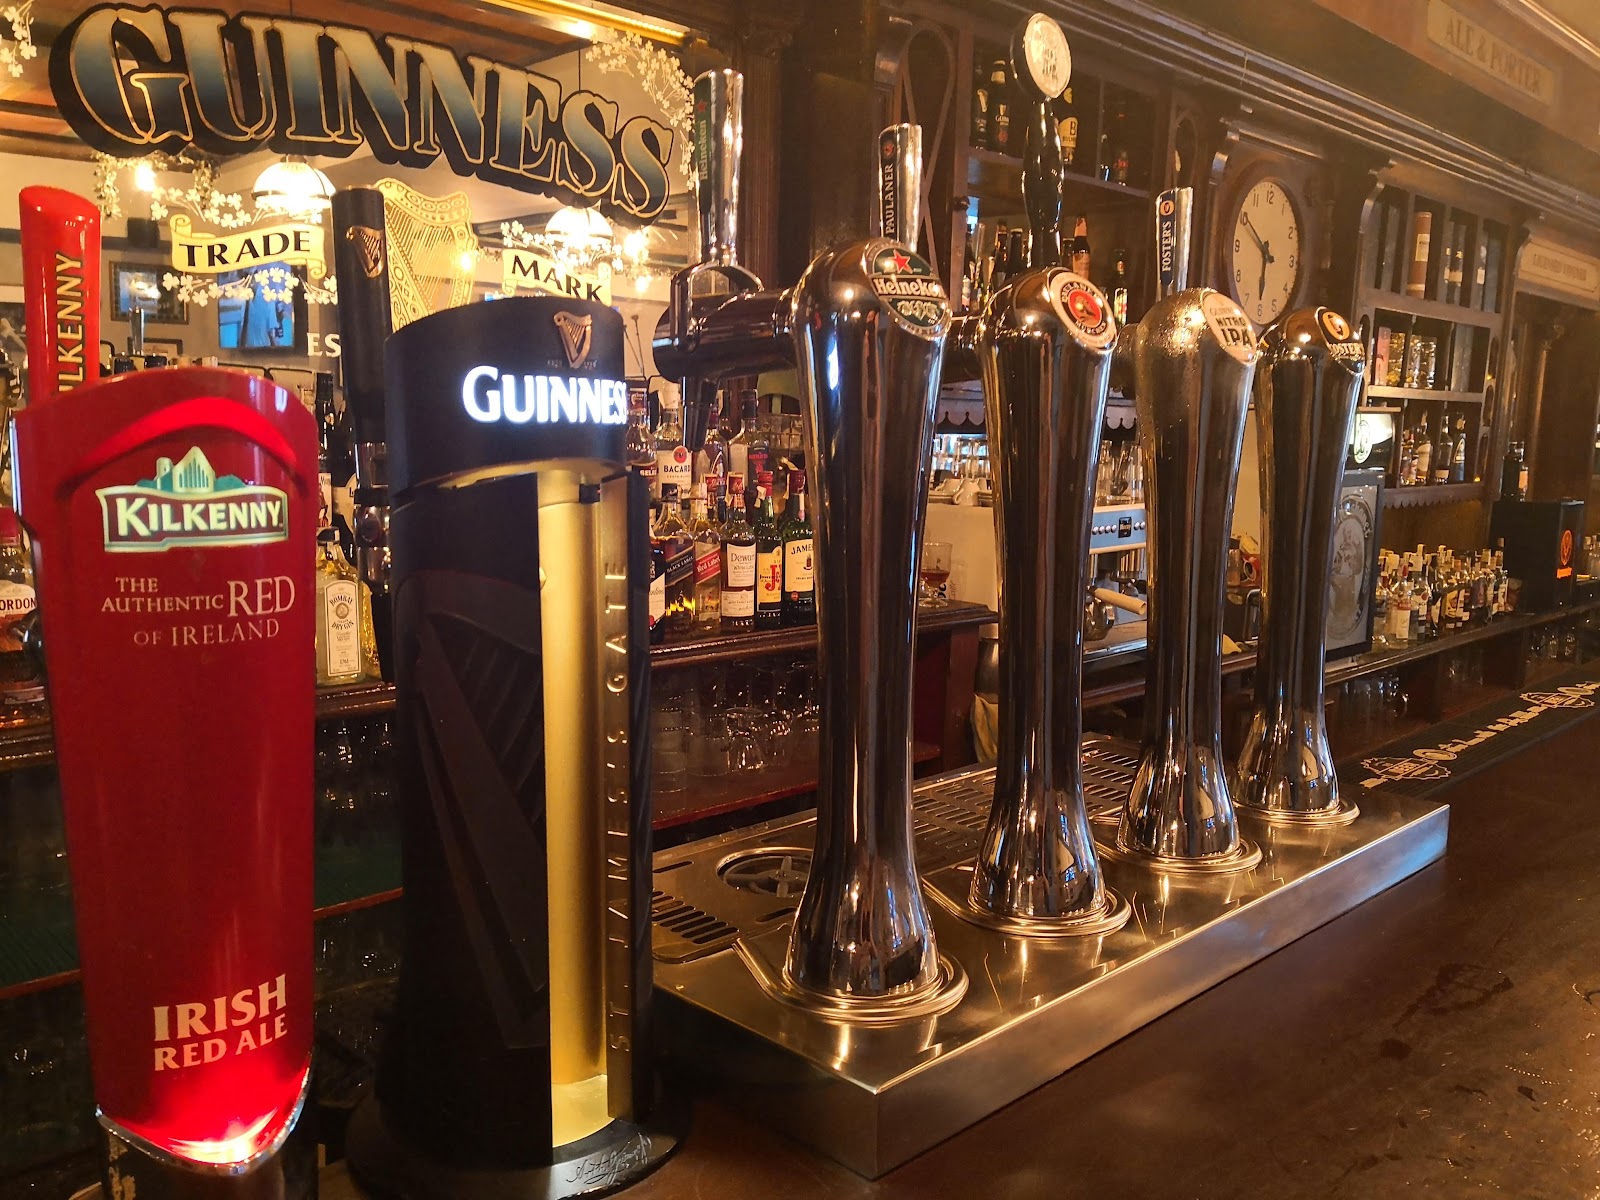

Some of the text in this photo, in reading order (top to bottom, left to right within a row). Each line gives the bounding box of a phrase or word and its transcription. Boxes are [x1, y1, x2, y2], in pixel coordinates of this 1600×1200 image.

[1445, 17, 1538, 93] ALE & PORTER
[50, 6, 672, 221] GUINNESS
[698, 120, 708, 181] Heineken
[885, 163, 895, 234] PAULANER
[1253, 193, 1259, 207] 11
[1266, 190, 1275, 204] 12
[1281, 203, 1285, 216] 1
[1288, 226, 1294, 240] 2
[179, 229, 311, 266] TRADE
[1161, 221, 1172, 272] FOSTER'S
[1234, 239, 1241, 253] 9
[1289, 255, 1295, 268] 3
[511, 254, 602, 302] MARK
[1235, 269, 1242, 283] 8
[1282, 282, 1288, 293] 4
[1244, 293, 1250, 306] 7
[1271, 299, 1277, 312] 5
[1257, 303, 1263, 317] 6
[1215, 317, 1247, 326] NITRO
[1221, 328, 1253, 347] IPA
[115, 497, 282, 537] KILKENNY
[667, 563, 681, 573] BLACK
[681, 555, 694, 566] LABEL
[696, 555, 721, 573] Red Label
[115, 576, 159, 593] THE
[101, 575, 296, 618] AUTHENTIC RED
[329, 594, 354, 608] BOMBAY
[133, 618, 280, 647] OF IRELAND
[331, 621, 343, 630] DRY
[343, 620, 355, 630] GIN
[604, 562, 628, 693] GATE
[606, 728, 629, 950] JAMES'S
[153, 972, 287, 1042] IRISH
[154, 1012, 288, 1071] RED ALE
